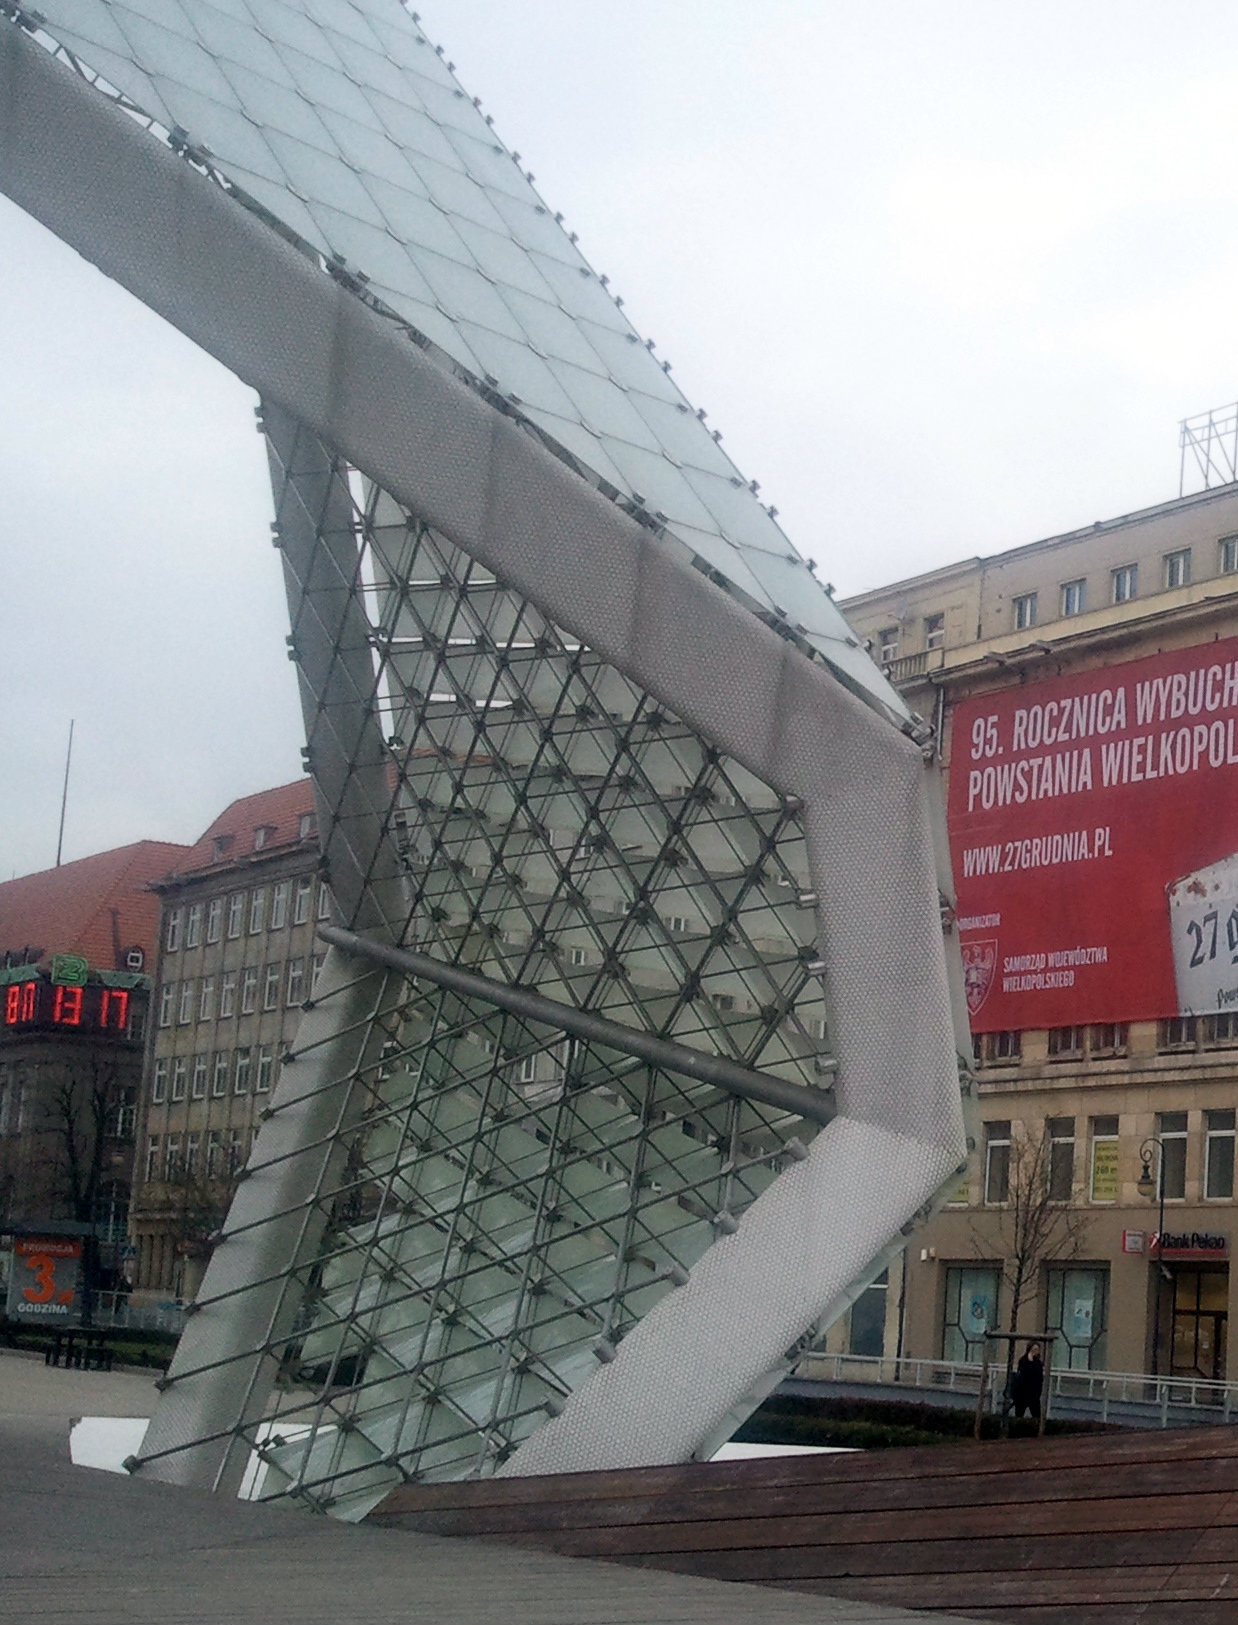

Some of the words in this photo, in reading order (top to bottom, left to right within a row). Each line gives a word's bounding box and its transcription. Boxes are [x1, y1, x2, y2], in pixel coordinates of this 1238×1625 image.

[971, 715, 1004, 760] 95.
[1013, 687, 1126, 751] ROCZNICA
[968, 748, 1092, 812] POWSTANIA
[963, 826, 1113, 878] WWW.27GRUDNIA.PL
[1186, 909, 1219, 969] 27
[1003, 953, 1047, 972] SAMORZĄD
[1048, 946, 1108, 968] WOJEWÓDZTWA
[1002, 970, 1075, 993] WIELKOPOLSKIEGO
[1163, 1232, 1190, 1249] Bank
[17, 1303, 68, 1314] GODZINA
